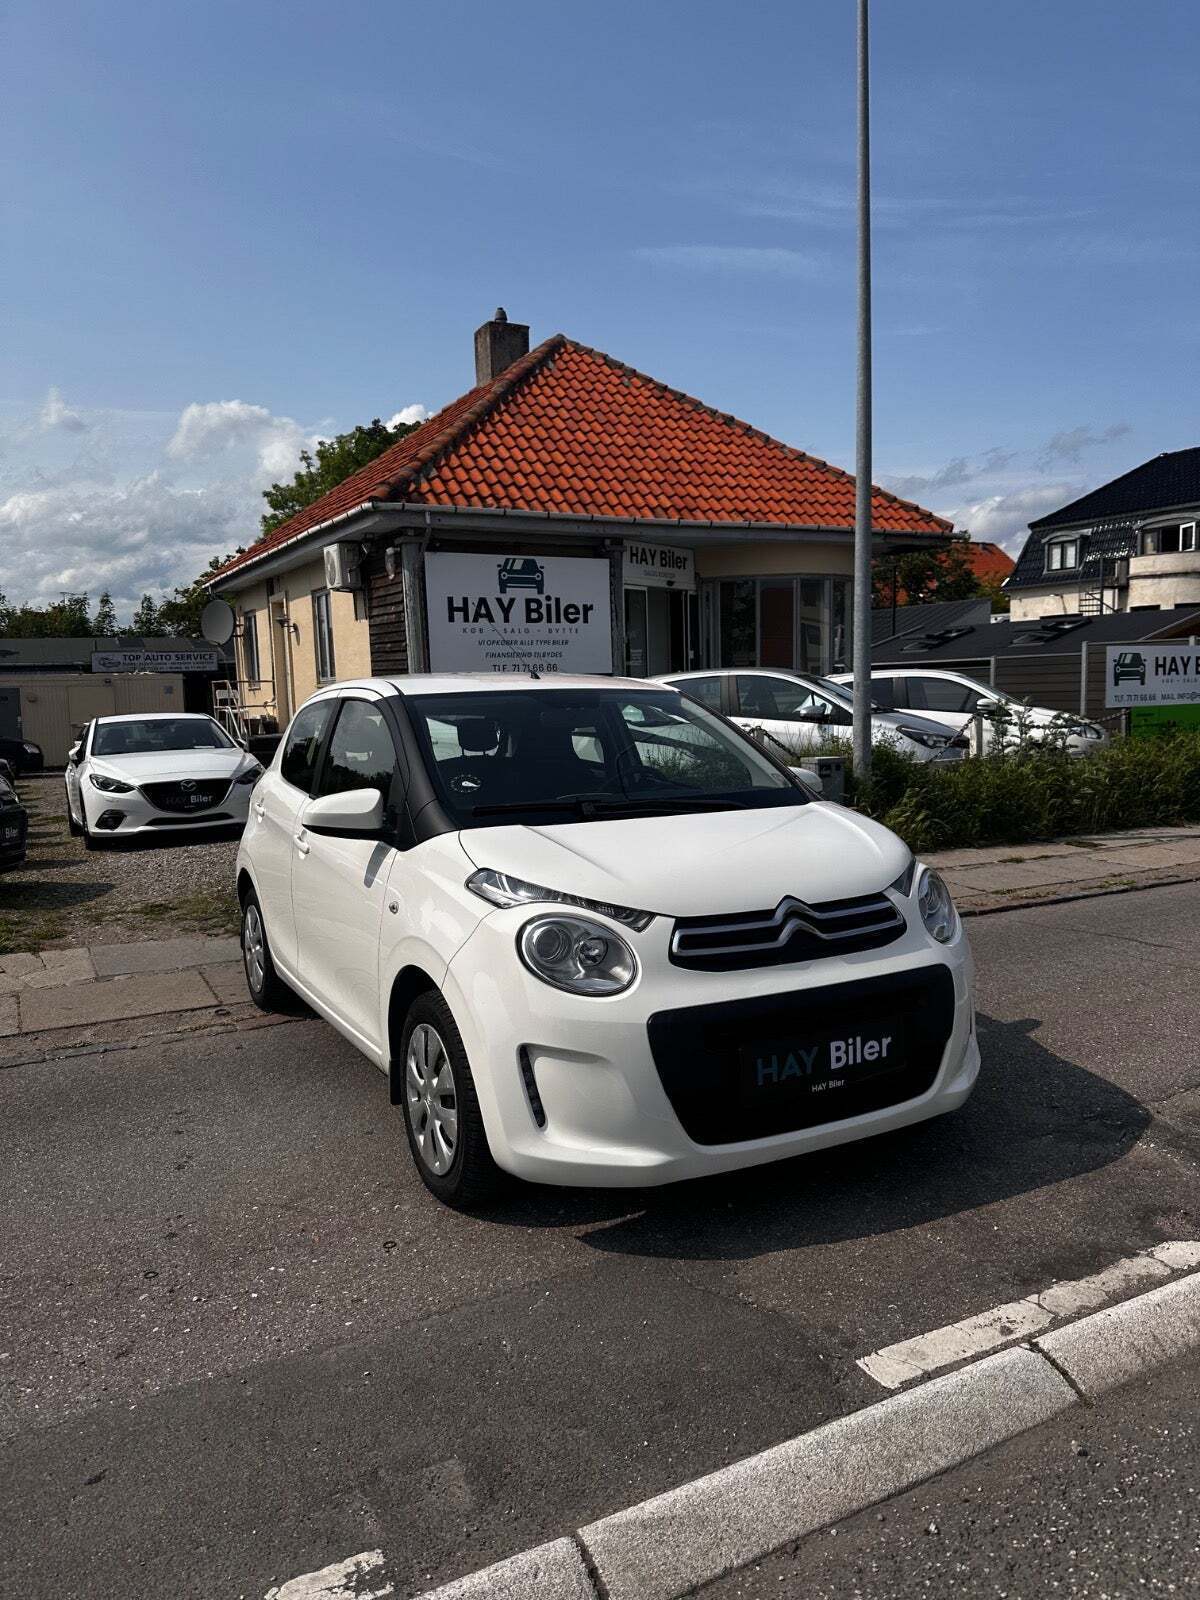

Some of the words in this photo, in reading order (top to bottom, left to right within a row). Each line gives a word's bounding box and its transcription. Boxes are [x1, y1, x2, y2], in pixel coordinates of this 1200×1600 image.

[629, 546, 657, 566] HAY
[659, 548, 688, 570] Biler
[447, 596, 516, 624] HAY
[524, 594, 594, 624] Biler
[122, 654, 141, 662] TOP
[175, 653, 215, 661] SERVICE
[1154, 656, 1191, 676] HAY
[511, 664, 520, 672] 71
[532, 664, 545, 672] 66
[546, 664, 558, 672] 66
[190, 794, 213, 803] Biler
[757, 1046, 819, 1086] HAY
[830, 1036, 892, 1070] Biler
[811, 1081, 827, 1093] HAY
[828, 1079, 845, 1089] Biler
